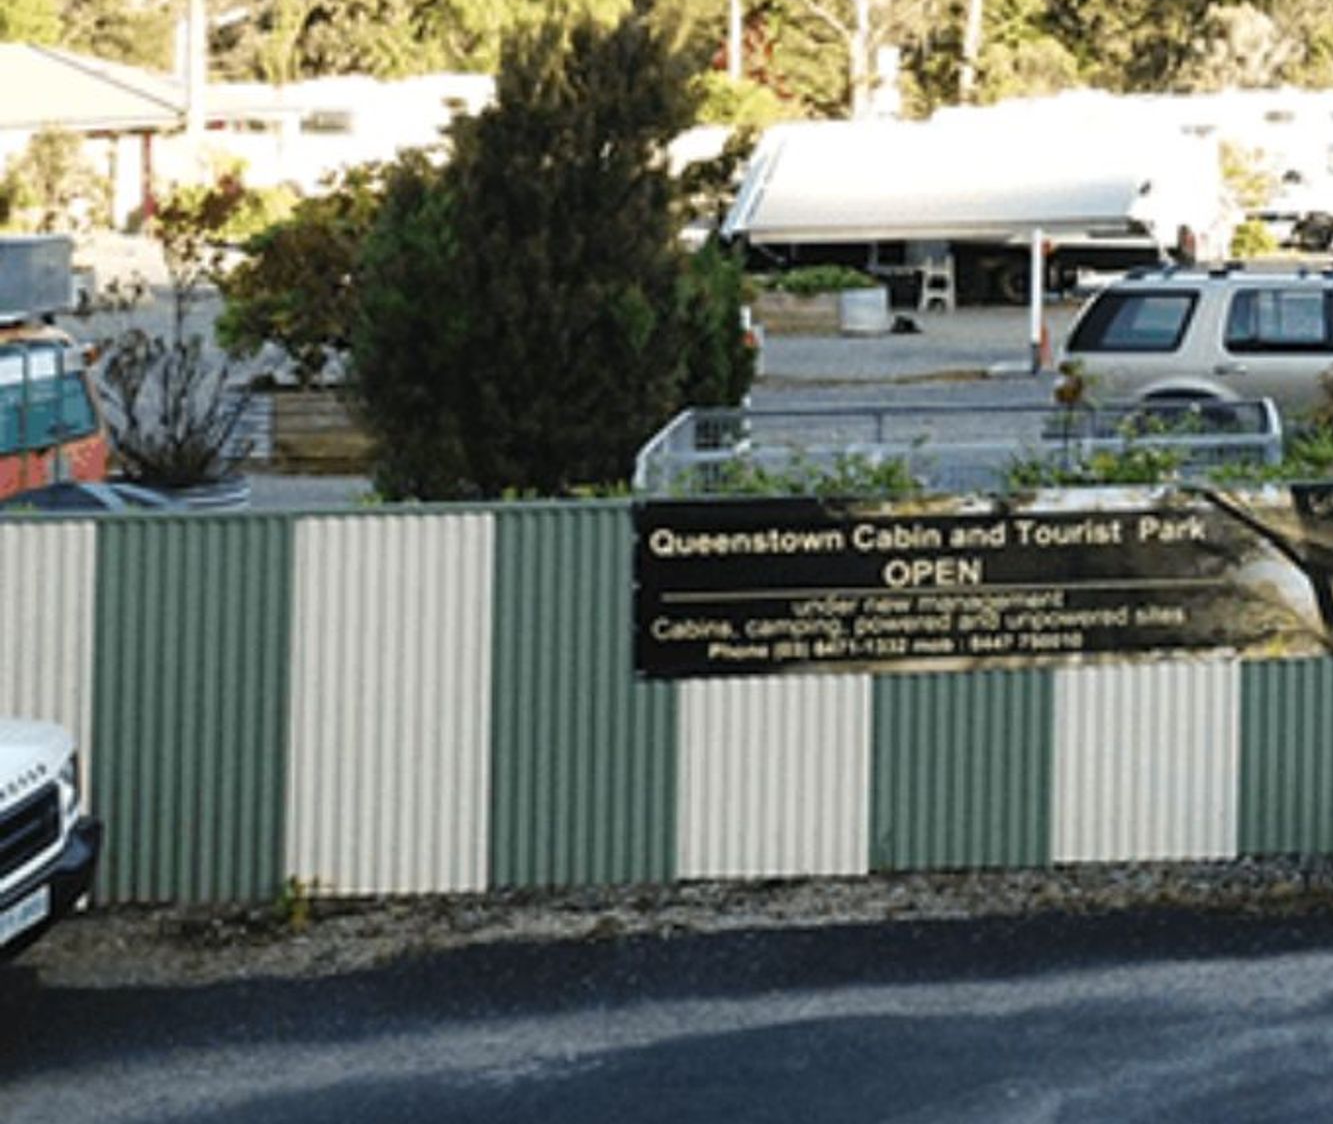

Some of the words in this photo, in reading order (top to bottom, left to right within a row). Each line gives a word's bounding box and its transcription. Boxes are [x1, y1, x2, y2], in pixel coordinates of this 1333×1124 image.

[650, 528, 844, 556] Queenstown
[853, 523, 942, 551] Cabin
[950, 522, 1006, 549] and
[1013, 519, 1122, 545] Tourist
[1138, 515, 1206, 542] Park
[884, 557, 983, 587] OPEN
[792, 593, 856, 617] under
[863, 596, 912, 614] new
[918, 589, 1065, 617] management
[854, 612, 950, 637] powered
[958, 606, 1001, 629] and
[1003, 605, 1129, 630] unpowered
[1134, 604, 1185, 625] sites
